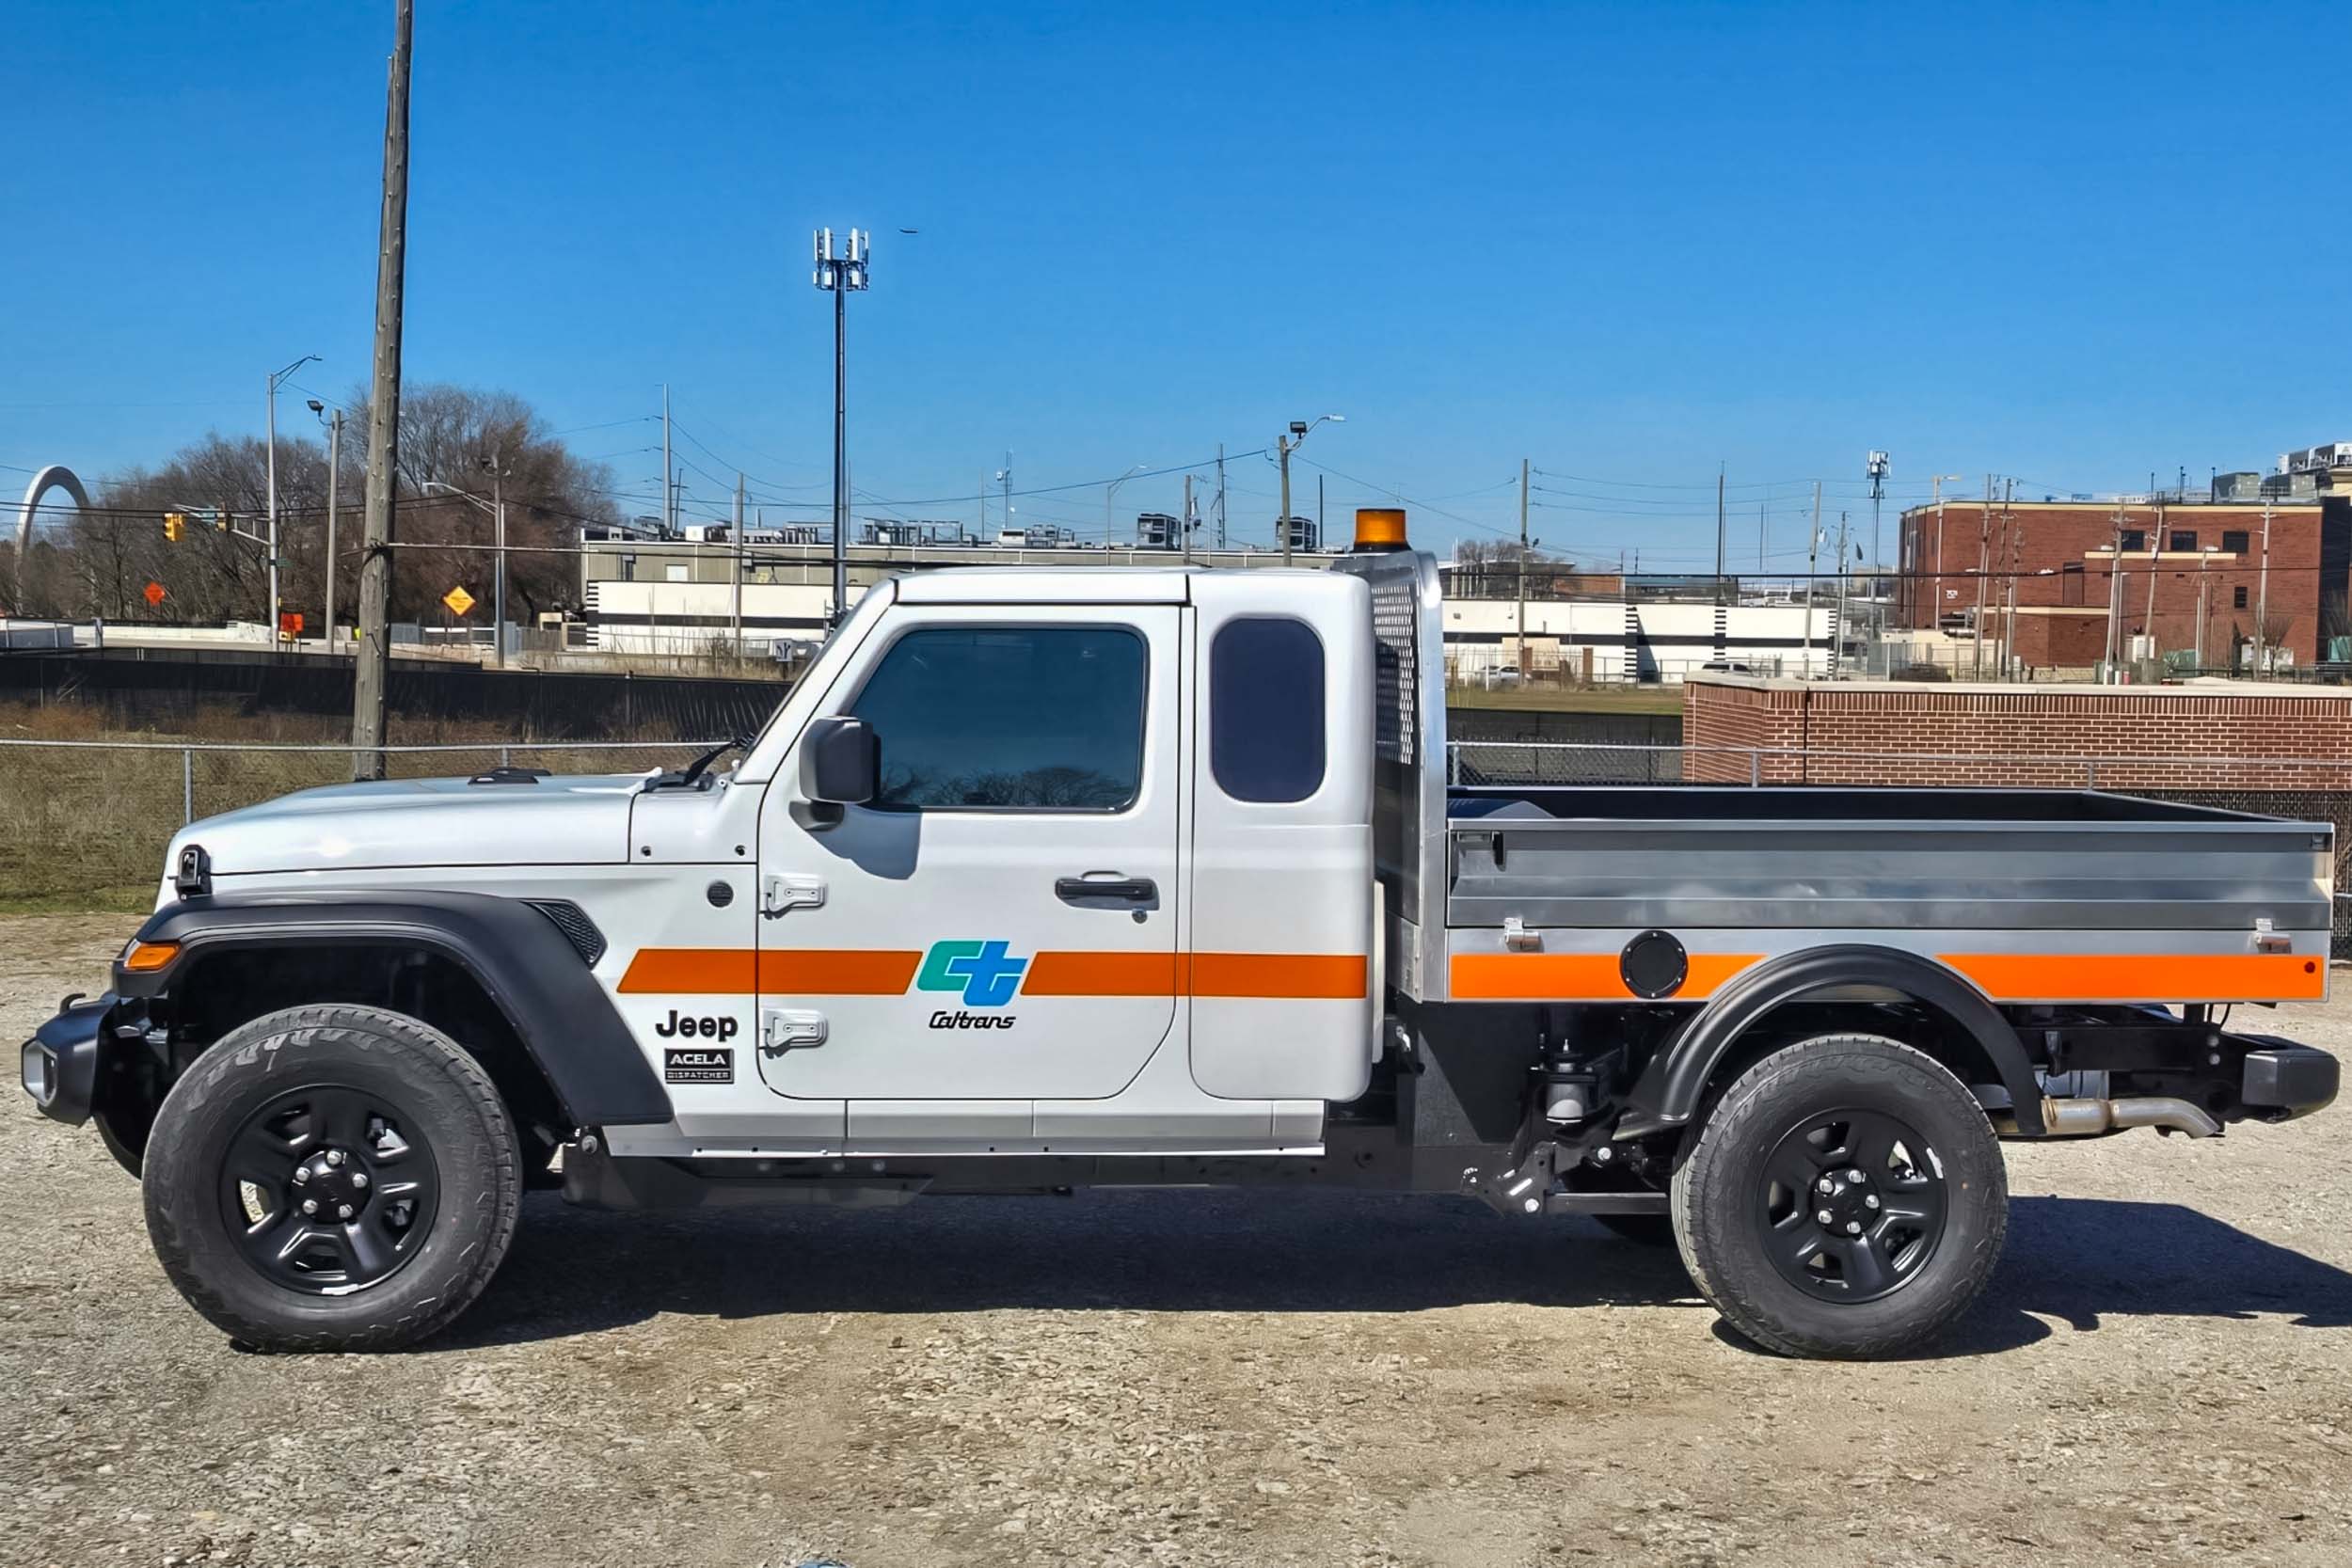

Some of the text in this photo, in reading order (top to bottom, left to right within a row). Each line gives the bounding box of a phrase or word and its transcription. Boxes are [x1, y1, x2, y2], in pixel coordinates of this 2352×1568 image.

[655, 1009, 739, 1042] Jeep
[929, 1010, 1016, 1029] Caltrans
[670, 1053, 726, 1065] ACELA
